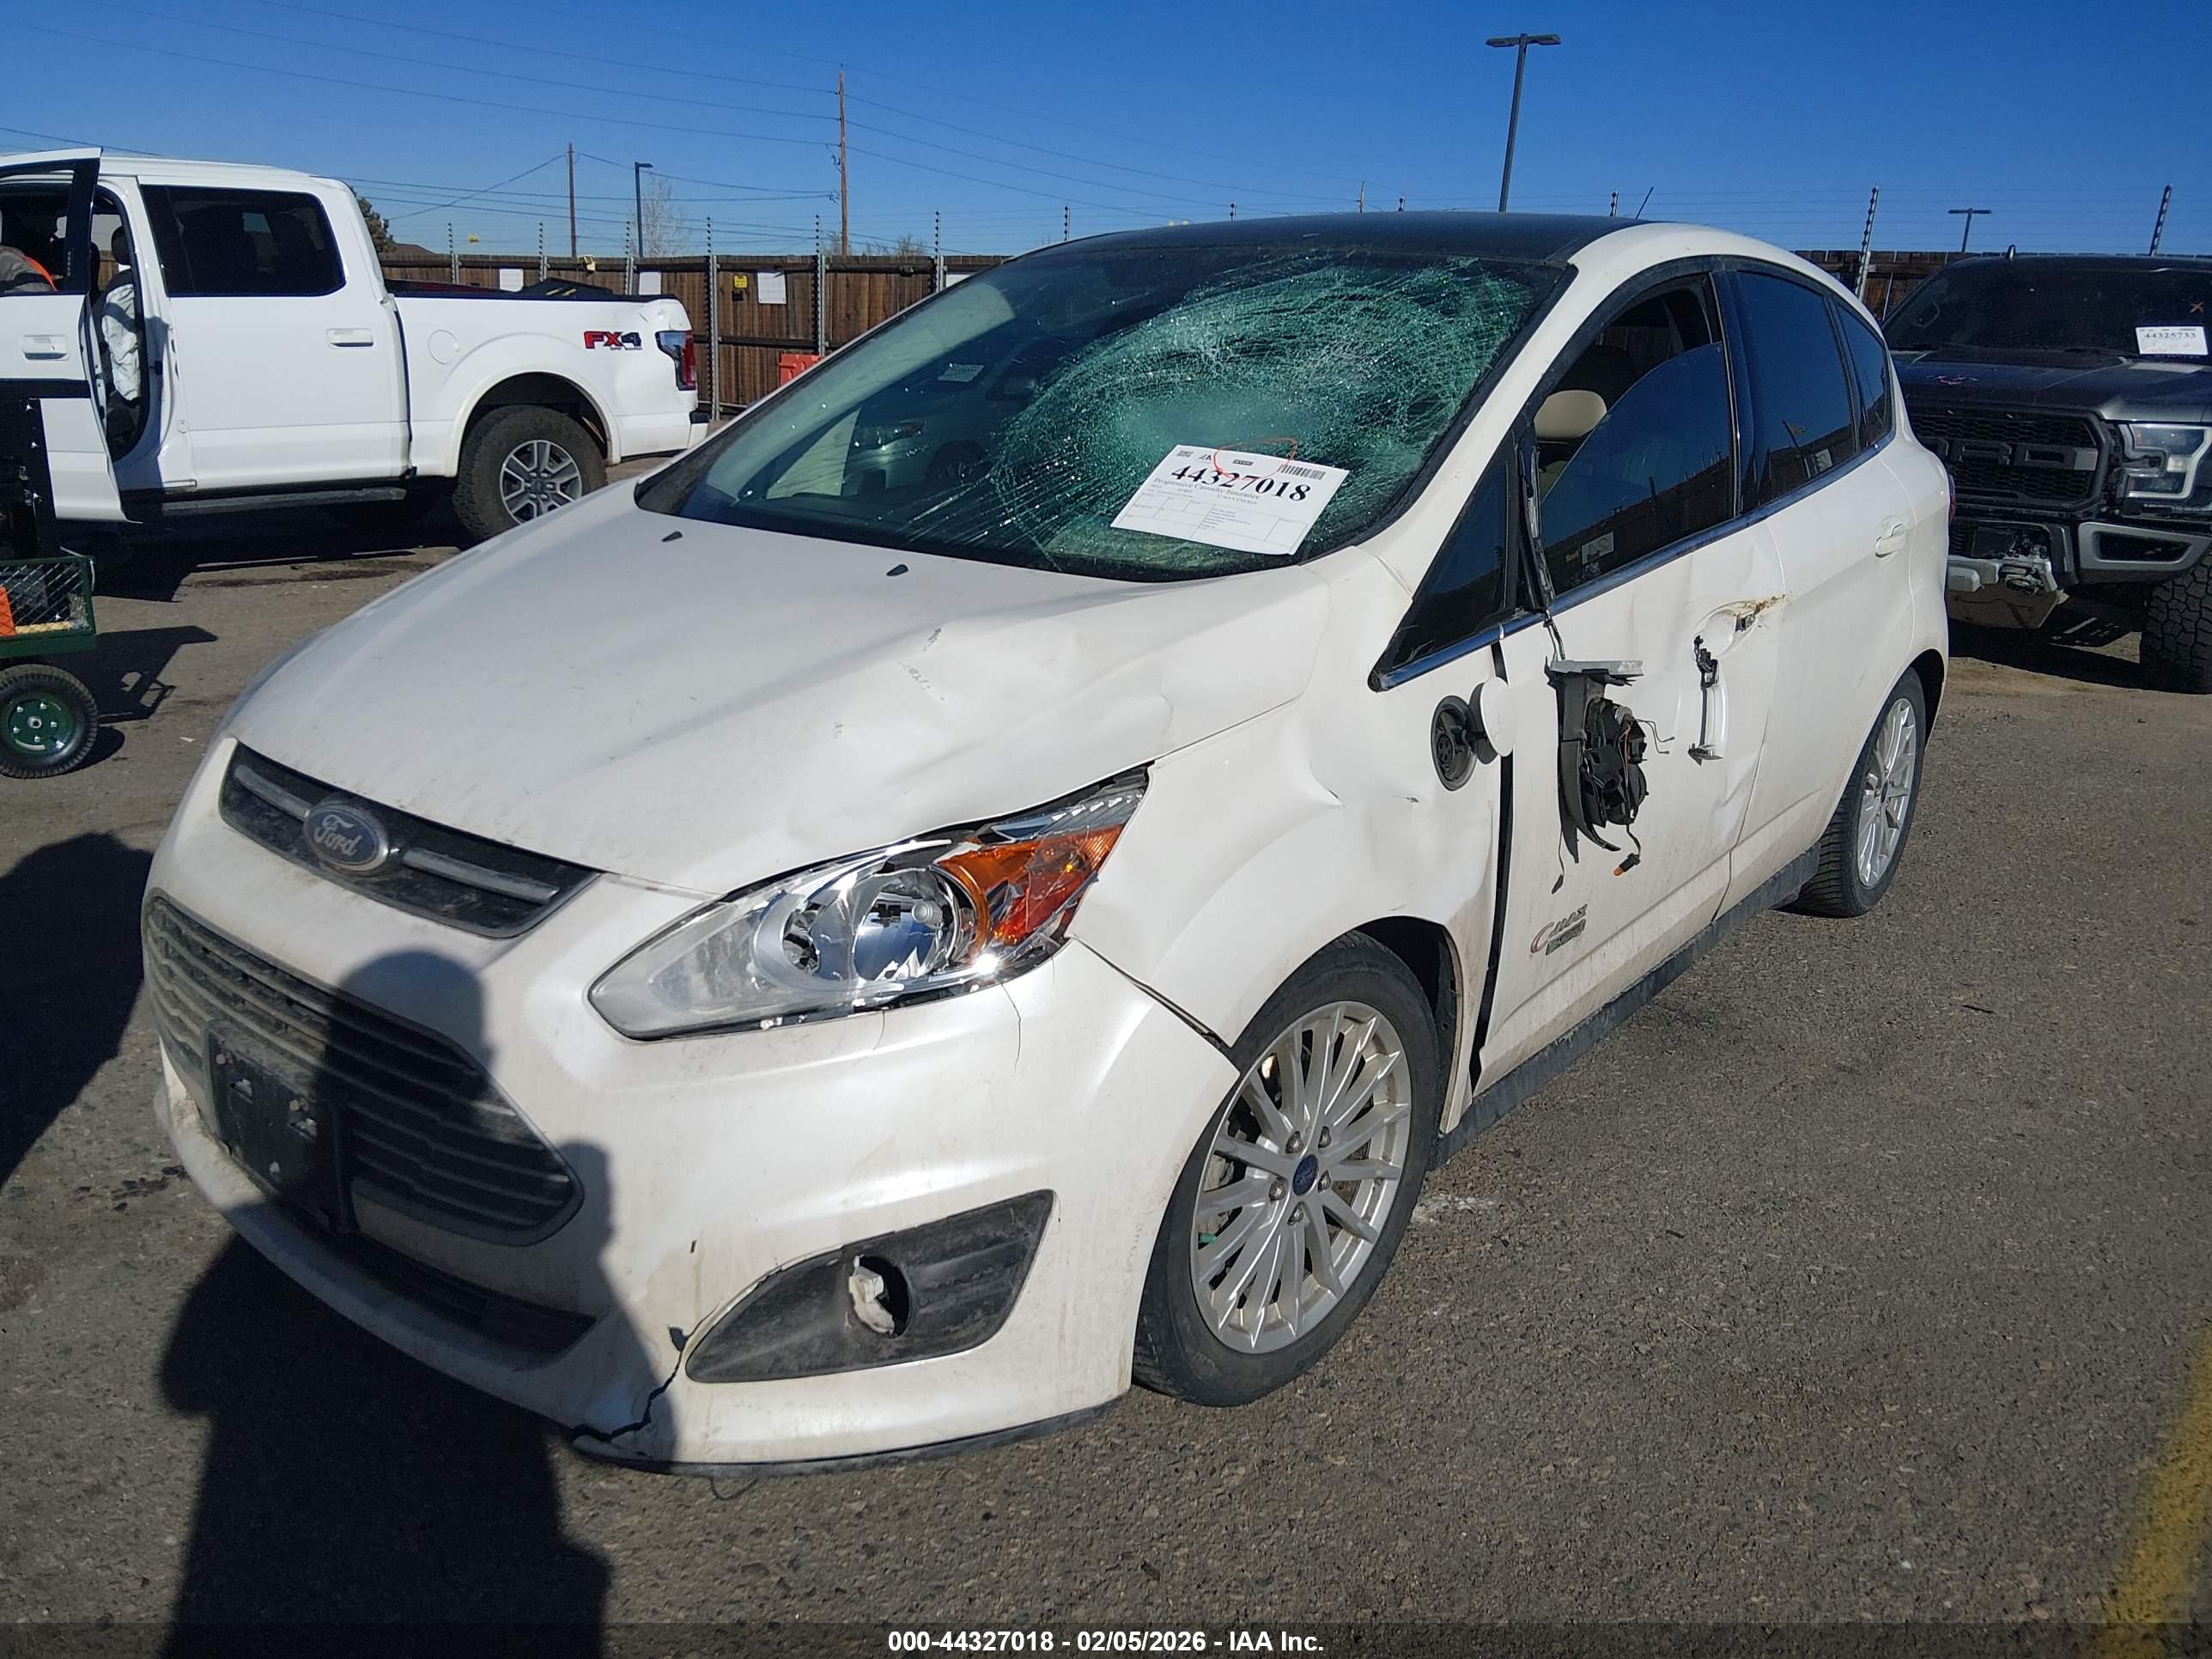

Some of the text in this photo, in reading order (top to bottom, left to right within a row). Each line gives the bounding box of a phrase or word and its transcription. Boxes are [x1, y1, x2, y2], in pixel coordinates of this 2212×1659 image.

[584, 331, 641, 349] FX4
[1153, 477, 1194, 489] Progressive
[1170, 465, 1312, 501] 44327018
[313, 814, 362, 856] Ford
